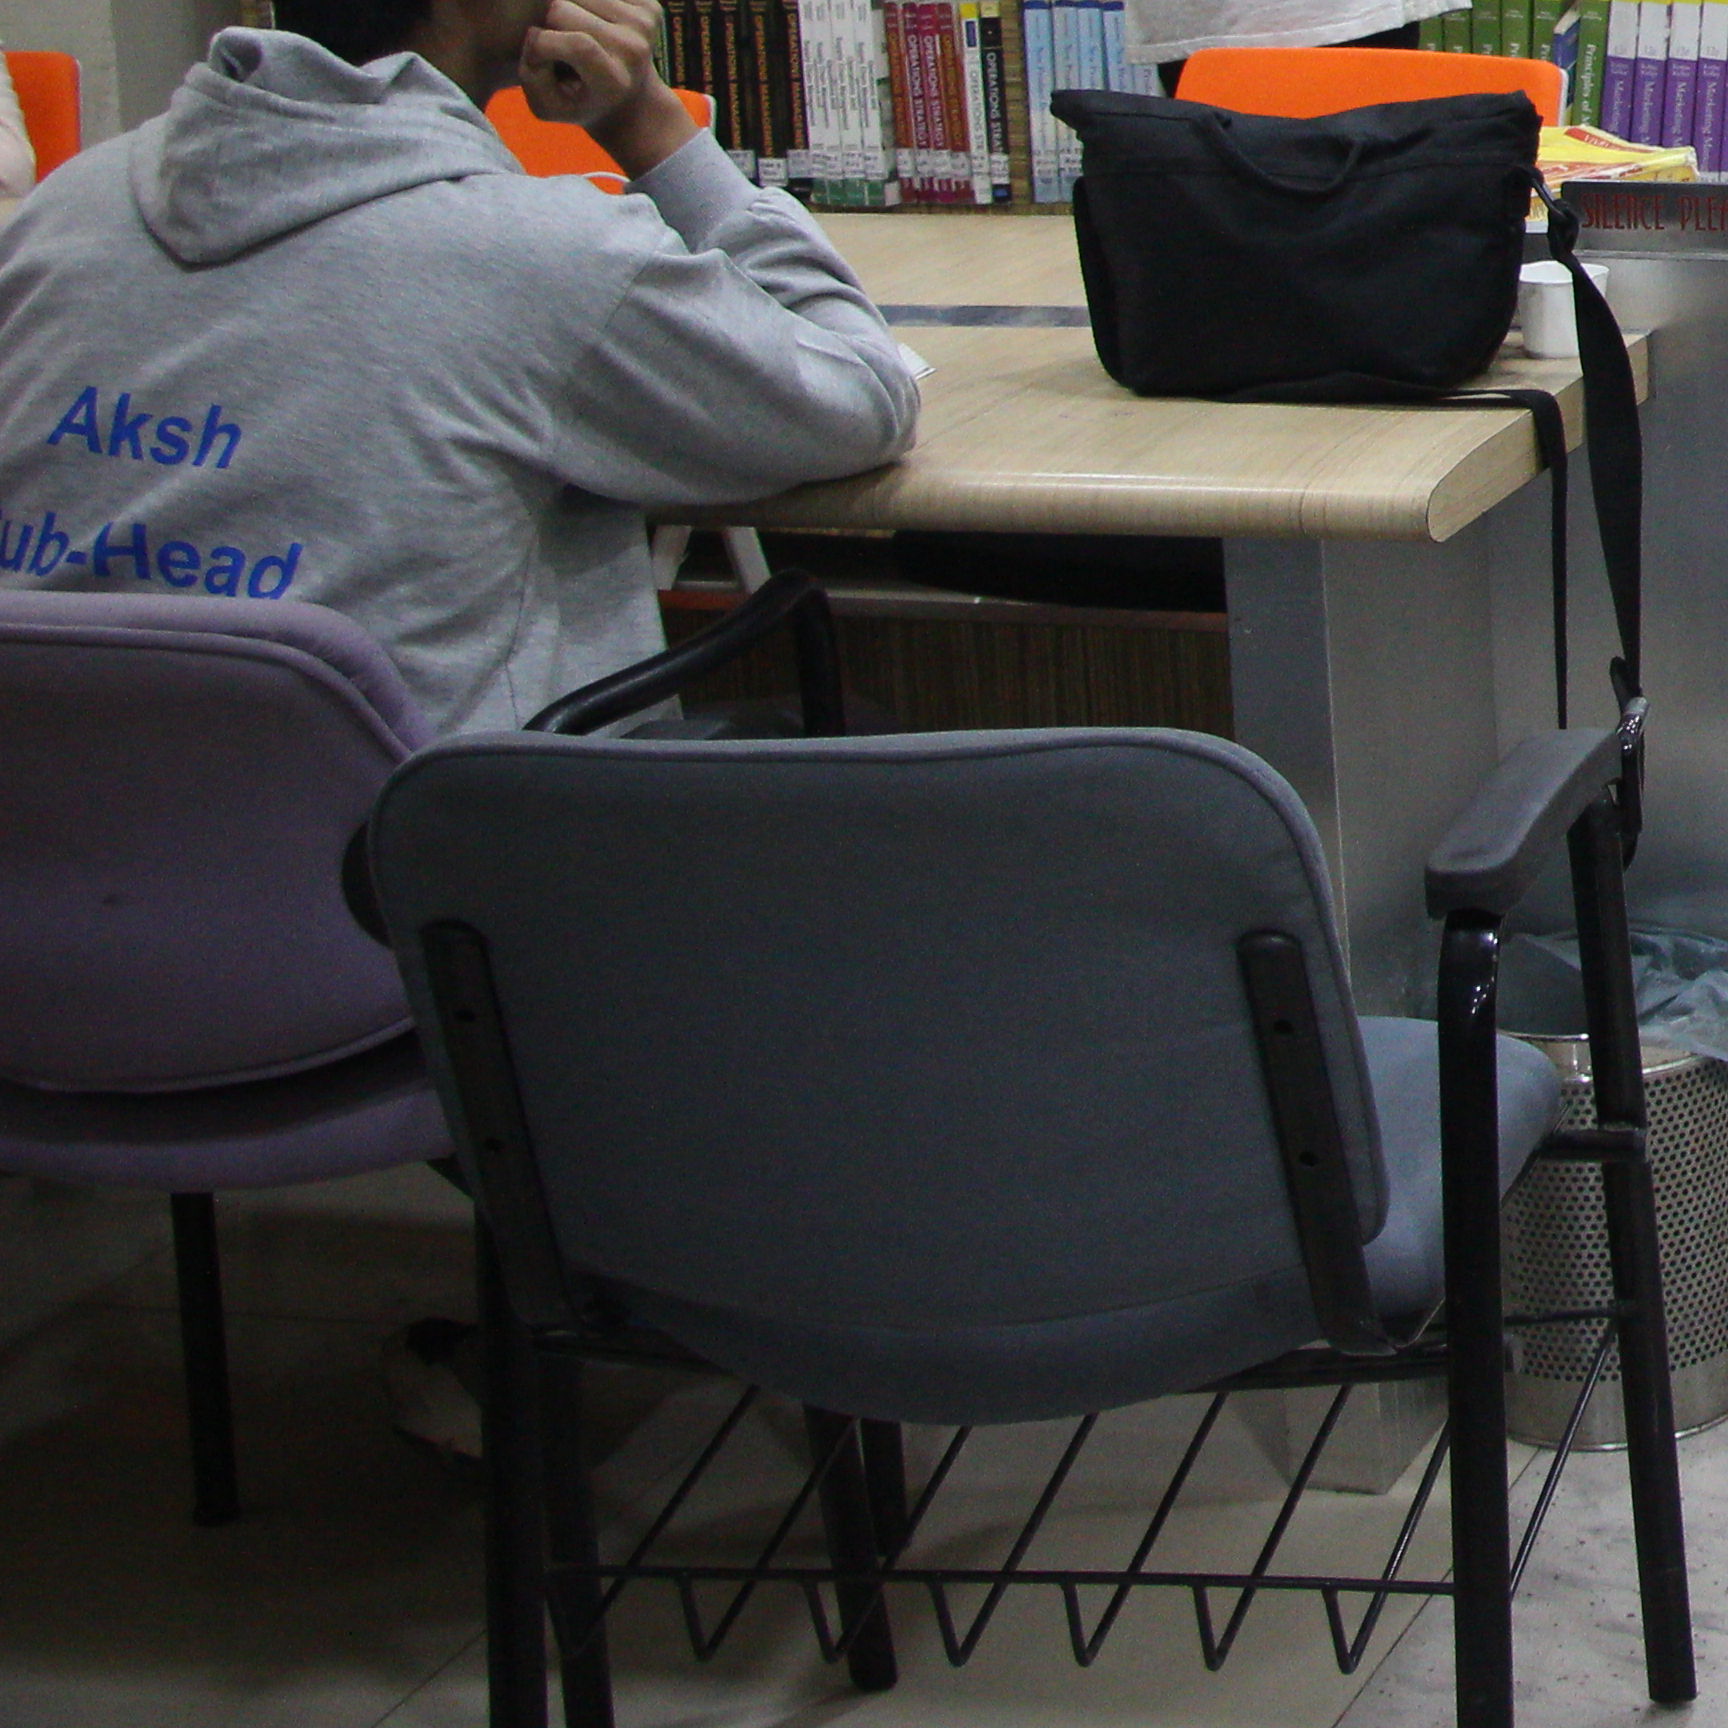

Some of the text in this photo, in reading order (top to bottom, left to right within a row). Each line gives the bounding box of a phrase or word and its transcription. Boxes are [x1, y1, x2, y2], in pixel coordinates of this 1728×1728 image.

[1581, 44, 1597, 100] Principles
[1581, 193, 1665, 230] SILENCE
[46, 385, 242, 469] Aksh
[0, 509, 304, 600] ub-Head
